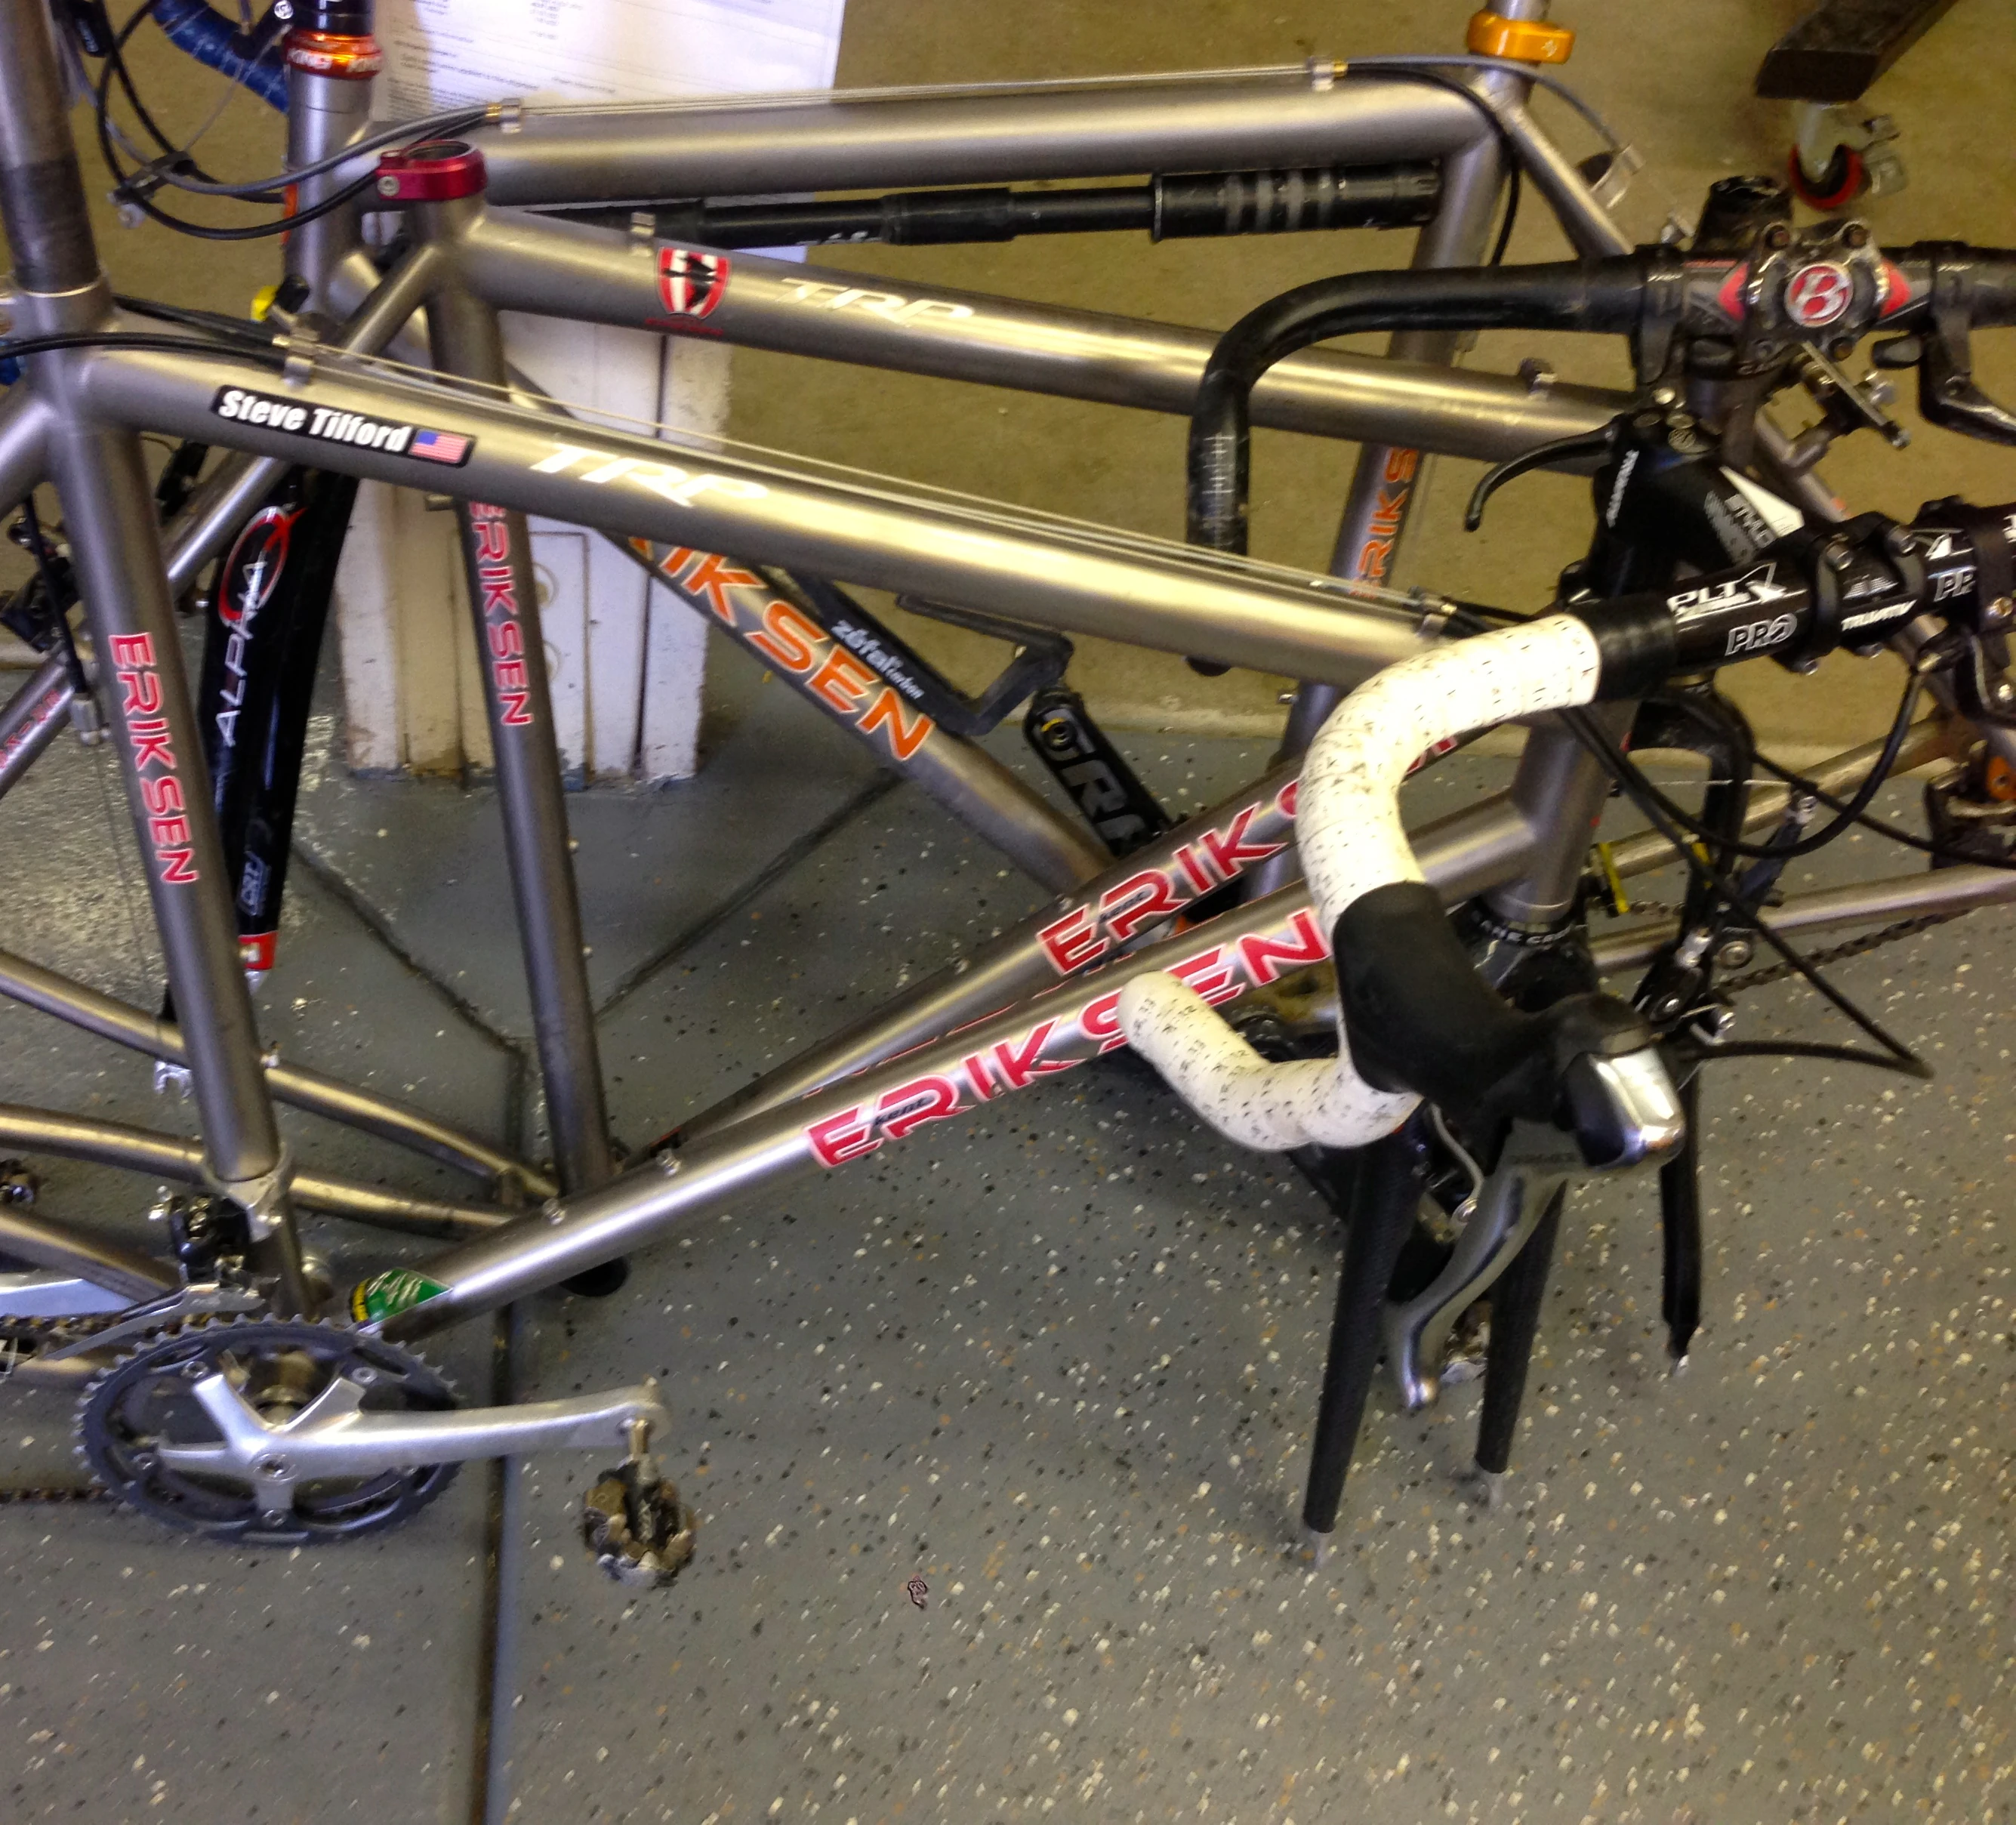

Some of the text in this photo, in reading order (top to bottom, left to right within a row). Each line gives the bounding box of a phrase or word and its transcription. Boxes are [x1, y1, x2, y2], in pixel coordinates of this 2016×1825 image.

[775, 277, 974, 328] TRP
[218, 390, 414, 453] Steve Tilford
[529, 442, 769, 507] TRP
[1933, 567, 1978, 603] PR
[1724, 612, 1798, 657] PRO
[108, 631, 199, 883] ERIKSEN
